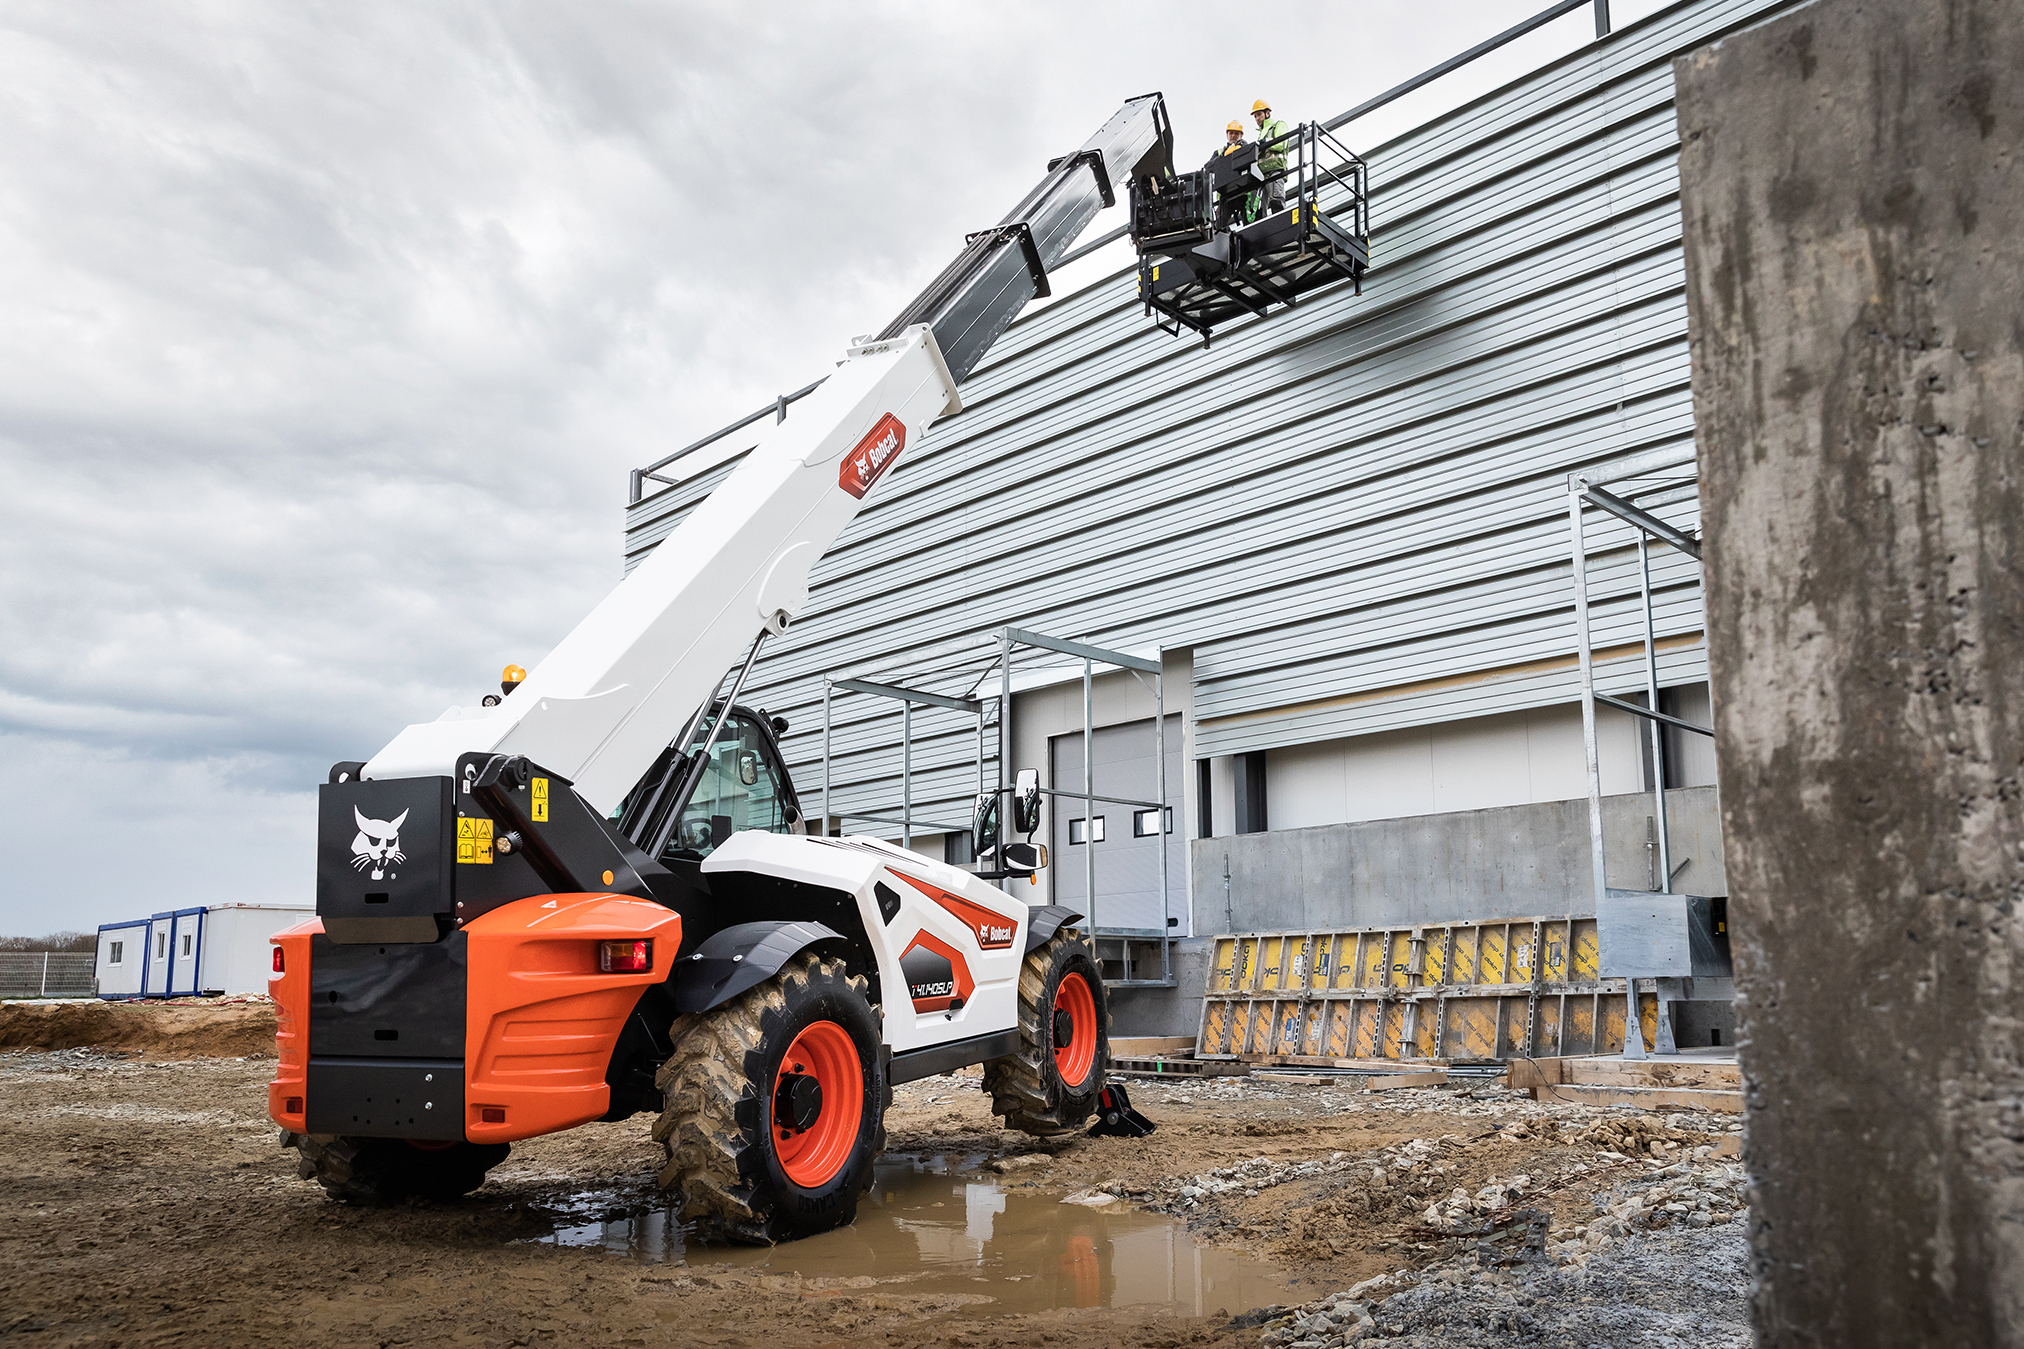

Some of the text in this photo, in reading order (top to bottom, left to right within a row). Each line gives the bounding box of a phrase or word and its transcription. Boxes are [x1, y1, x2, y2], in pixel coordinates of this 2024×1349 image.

[868, 427, 898, 470] Bobcat
[990, 926, 1011, 941] Bobcat
[798, 1192, 836, 1214] CAMSO
